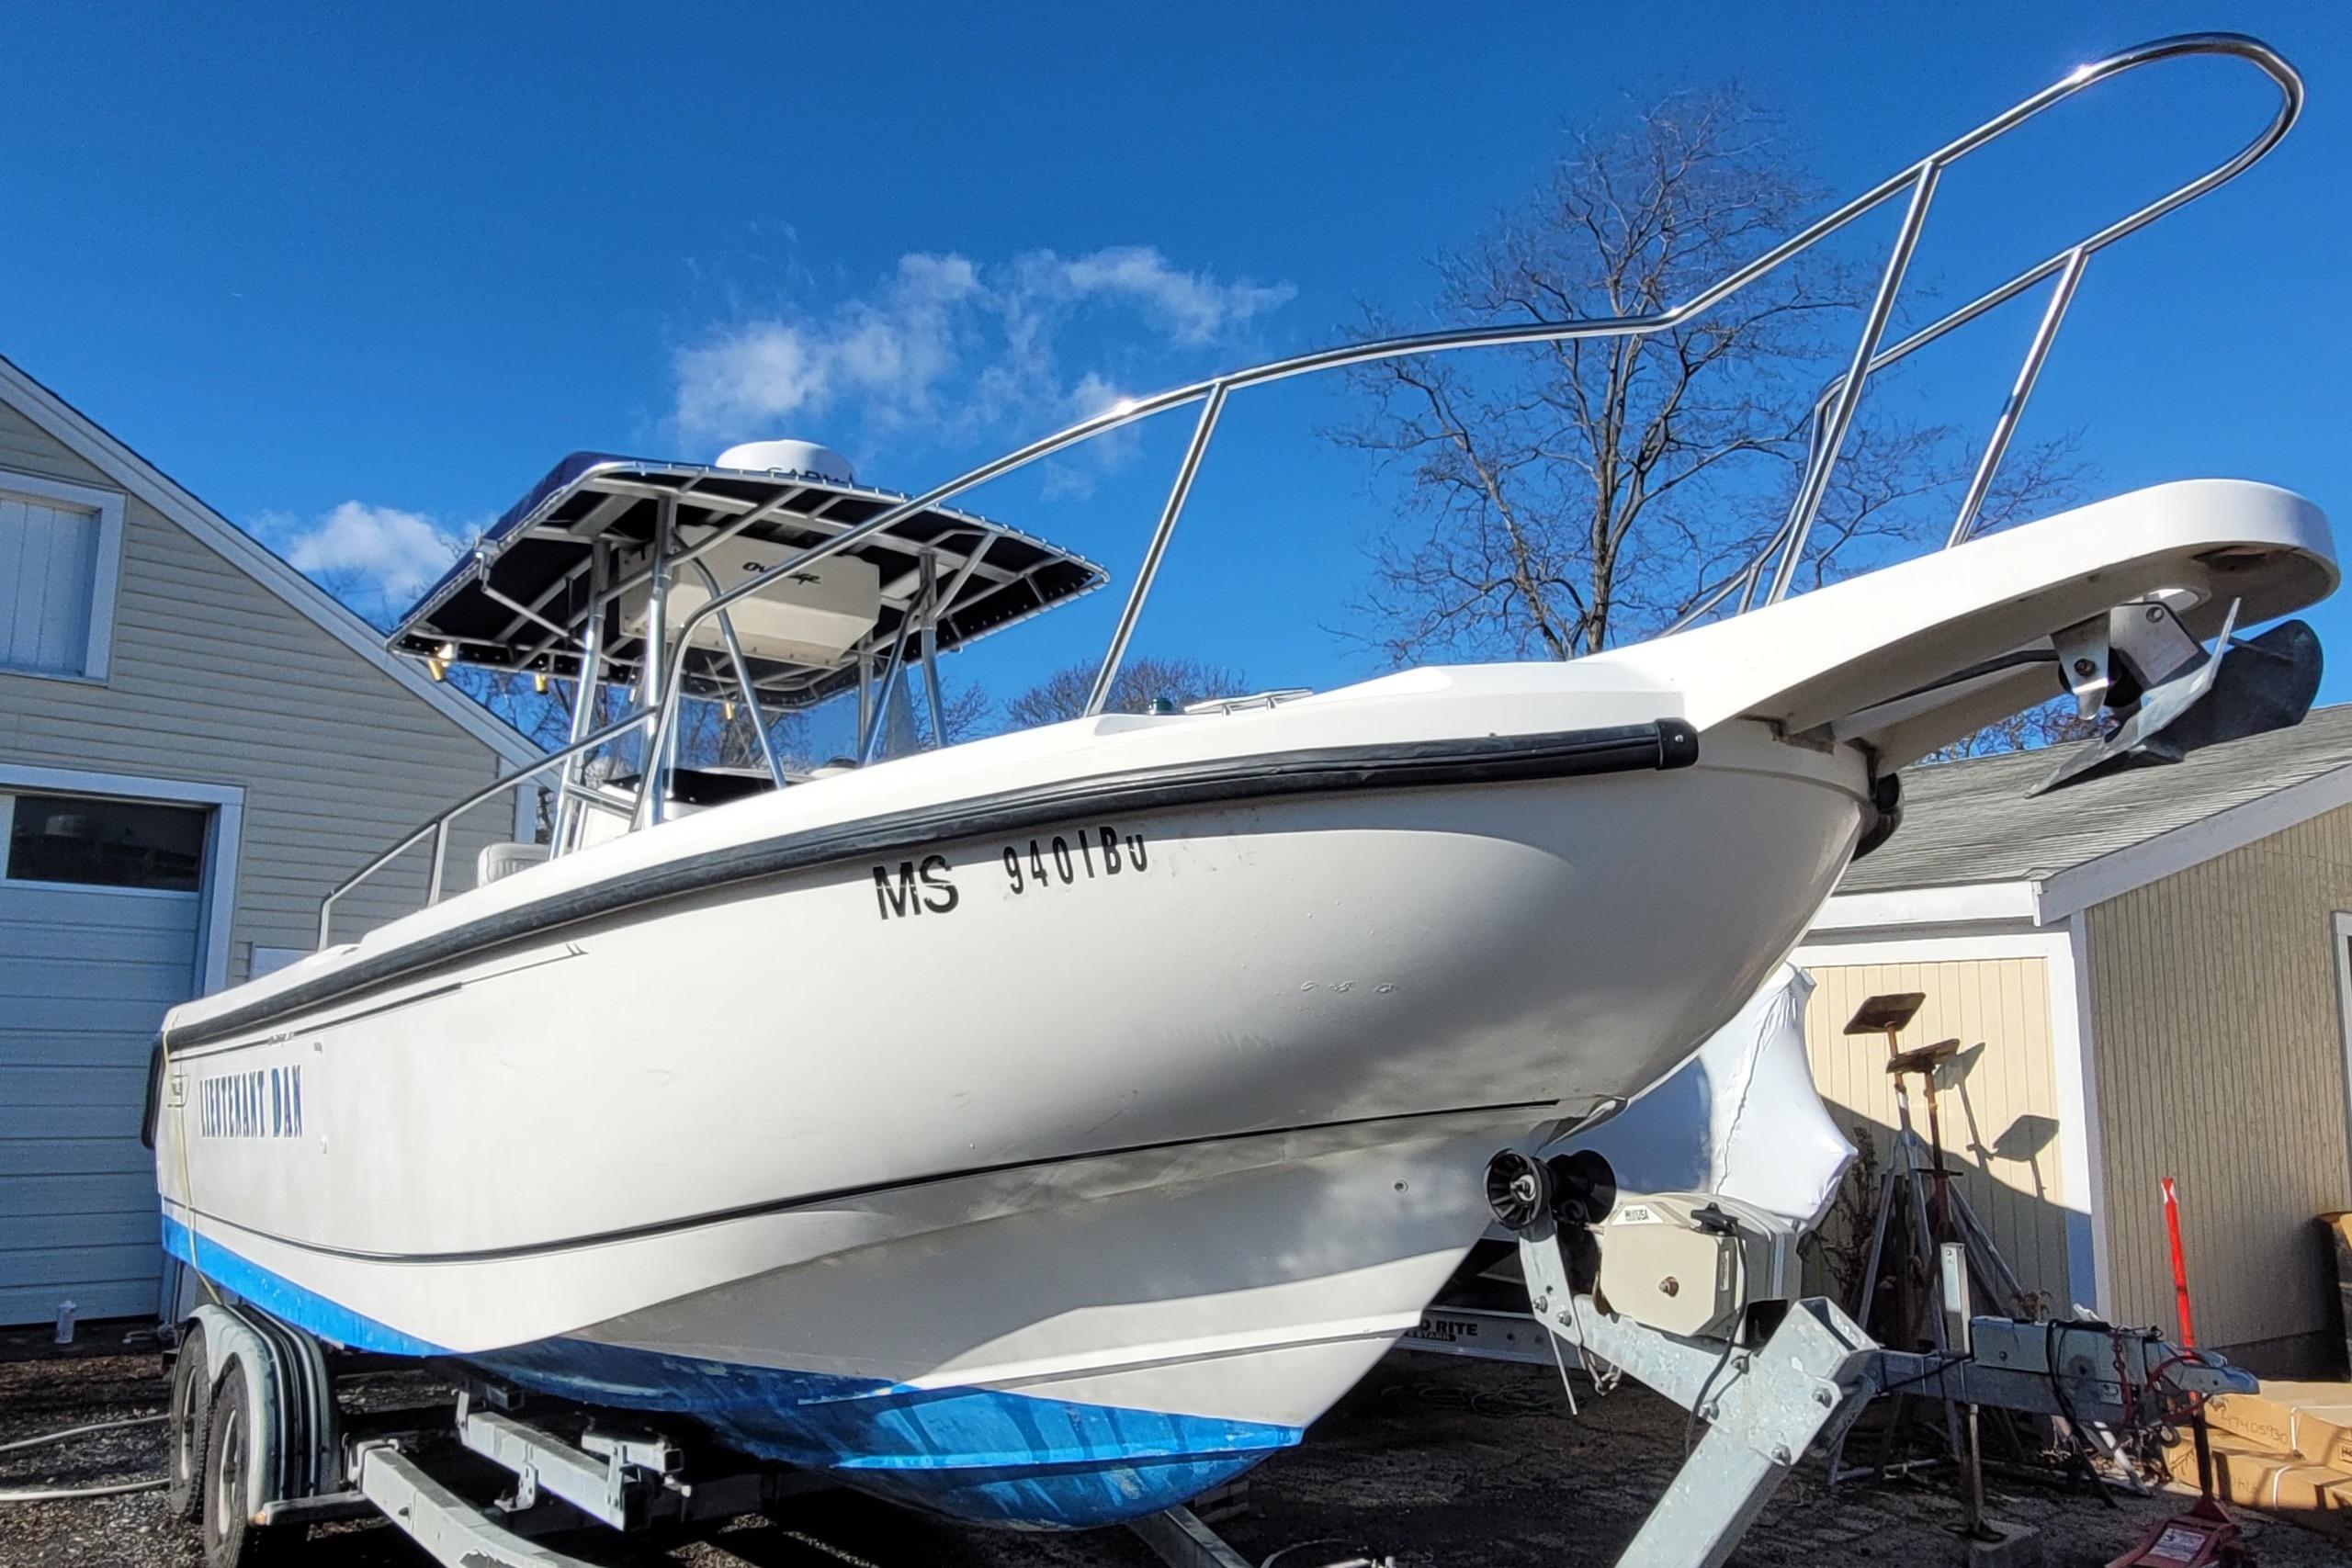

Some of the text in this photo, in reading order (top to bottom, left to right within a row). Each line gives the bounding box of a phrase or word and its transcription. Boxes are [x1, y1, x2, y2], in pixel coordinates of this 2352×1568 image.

[872, 853, 959, 920] MS
[271, 1064, 303, 1138] DAN
[1436, 1320, 1478, 1336] RITE
